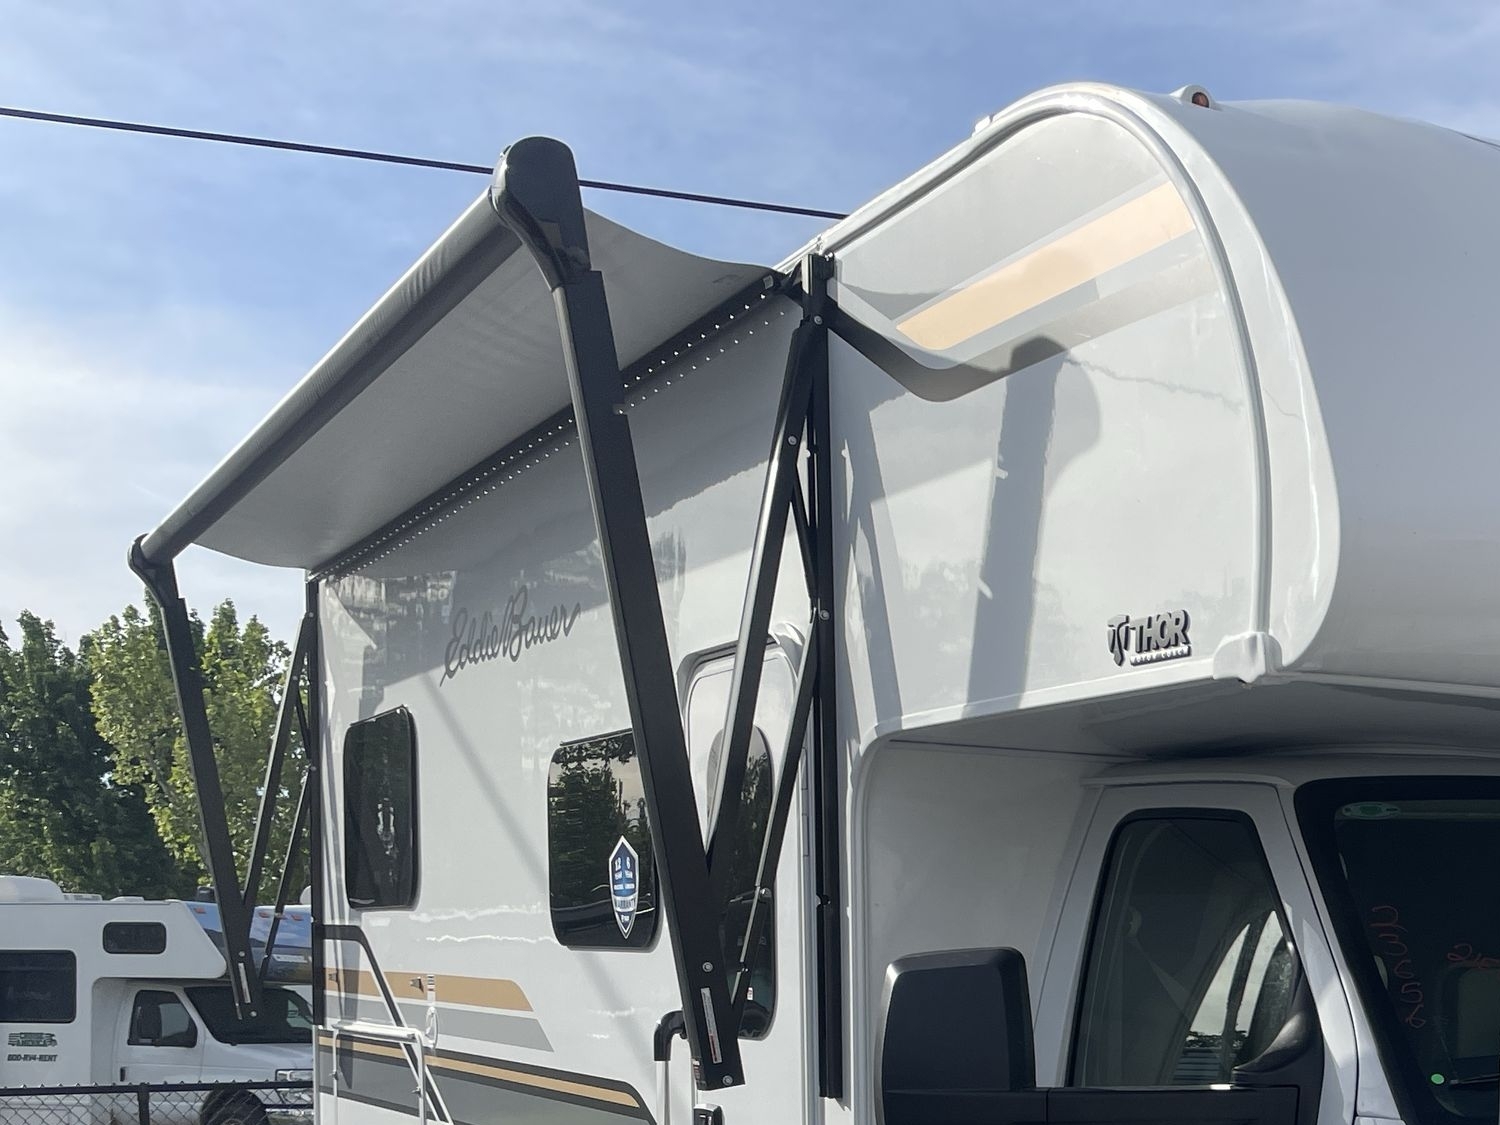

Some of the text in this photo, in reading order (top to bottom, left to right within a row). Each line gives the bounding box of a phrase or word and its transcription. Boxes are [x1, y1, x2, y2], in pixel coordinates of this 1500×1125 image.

[439, 584, 581, 688] Eddie Bauer
[1129, 609, 1191, 654] THOR
